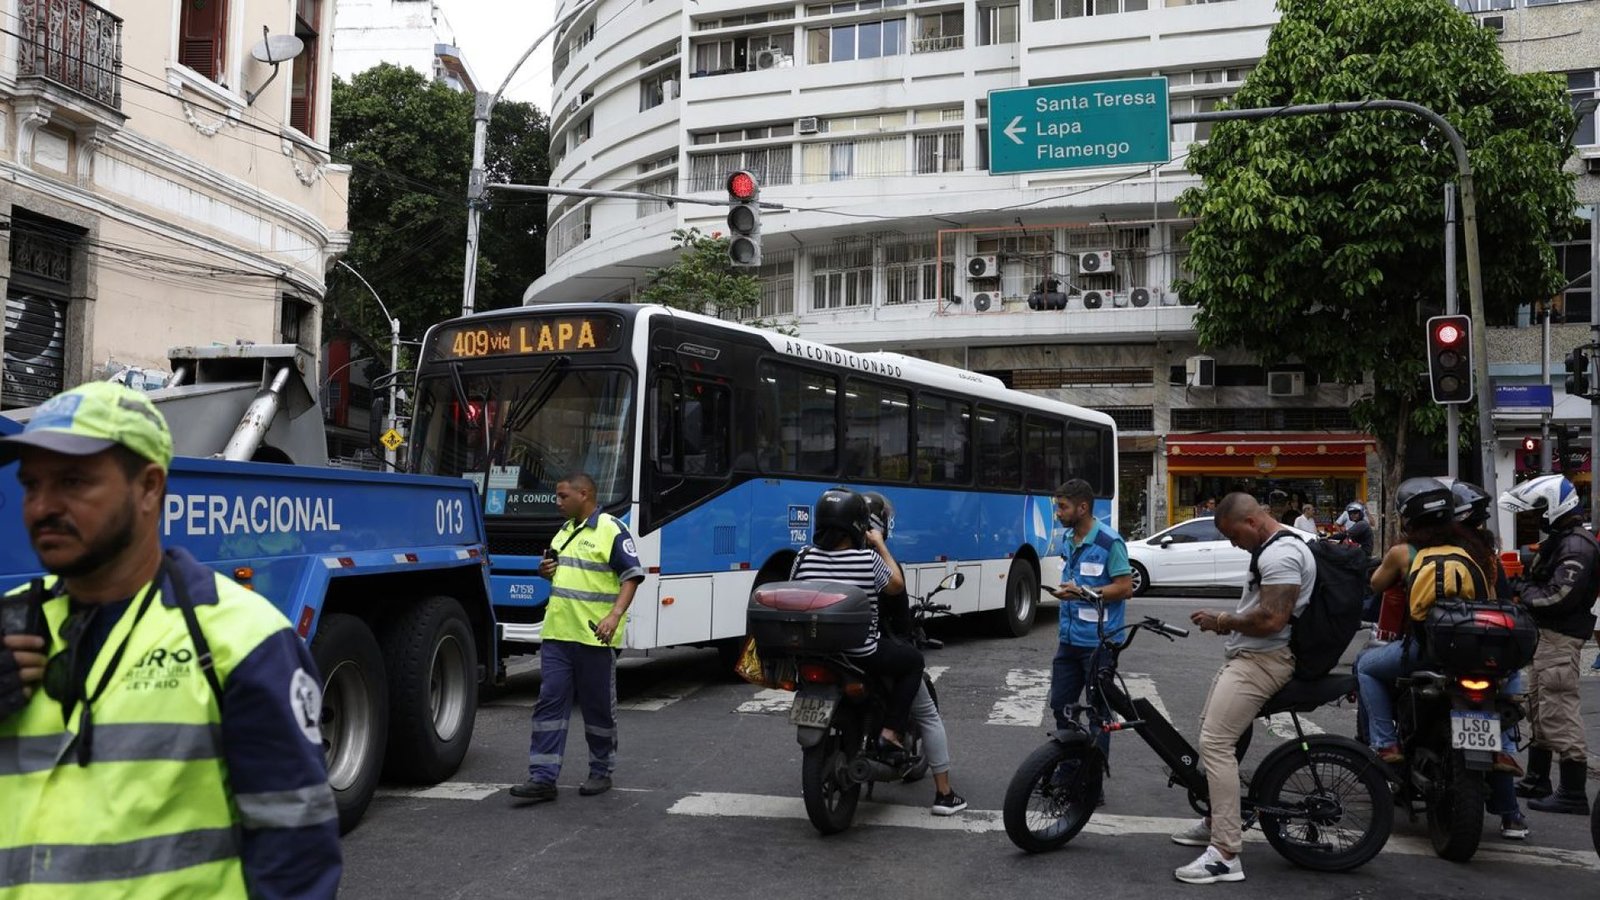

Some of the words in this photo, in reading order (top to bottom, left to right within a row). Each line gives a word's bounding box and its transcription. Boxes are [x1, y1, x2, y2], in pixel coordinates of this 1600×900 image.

[1036, 96, 1089, 113] Santa
[1093, 92, 1156, 108] Teresa
[1037, 121, 1082, 138] Lapa
[1037, 141, 1130, 159] Flamengo
[452, 330, 489, 357] 409
[490, 332, 511, 350] via
[520, 321, 596, 353] LAPA
[786, 341, 803, 357] AR
[807, 345, 903, 378] CONDICIONADO
[507, 494, 519, 504] AR
[522, 493, 557, 504] CONDIC
[164, 494, 341, 536] PERACIONAL
[436, 499, 464, 535] 013
[797, 510, 809, 522] Rio
[790, 529, 807, 542] 1746
[1462, 718, 1490, 733] LSQ
[1458, 732, 1496, 747] 9C56
